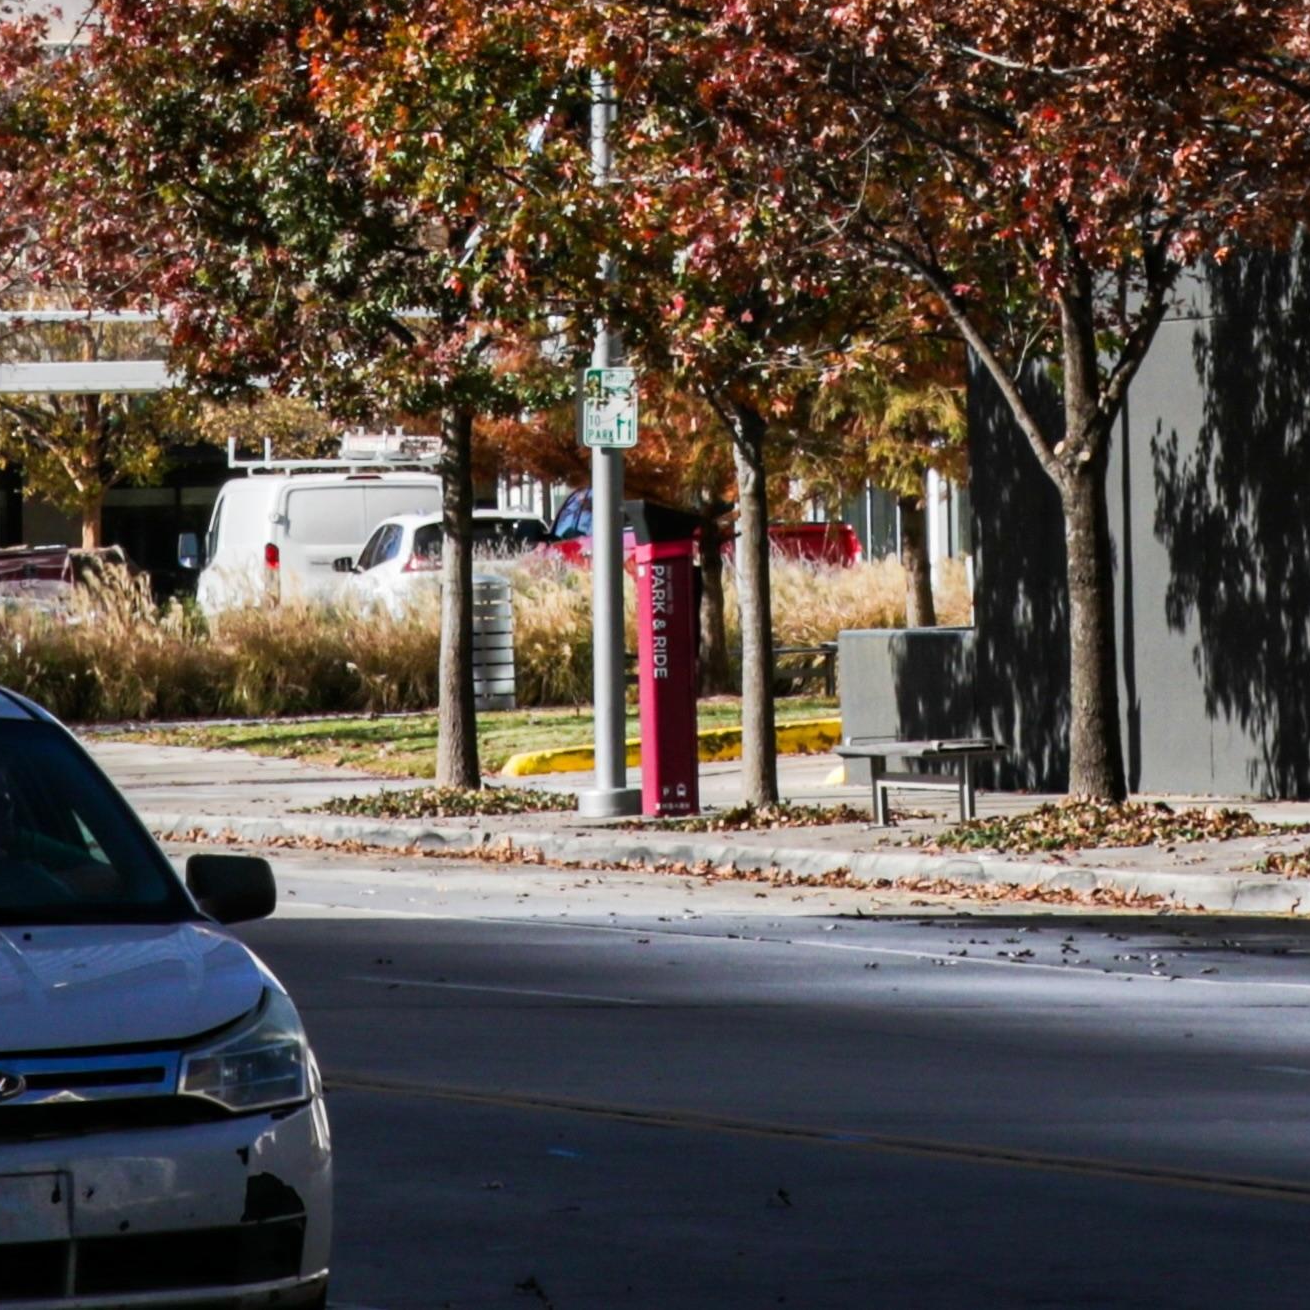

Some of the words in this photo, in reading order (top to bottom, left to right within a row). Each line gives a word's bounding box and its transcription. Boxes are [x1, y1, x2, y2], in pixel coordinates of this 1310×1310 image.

[651, 565, 666, 614] PARK
[652, 620, 667, 631] &
[653, 636, 668, 679] RIDE
